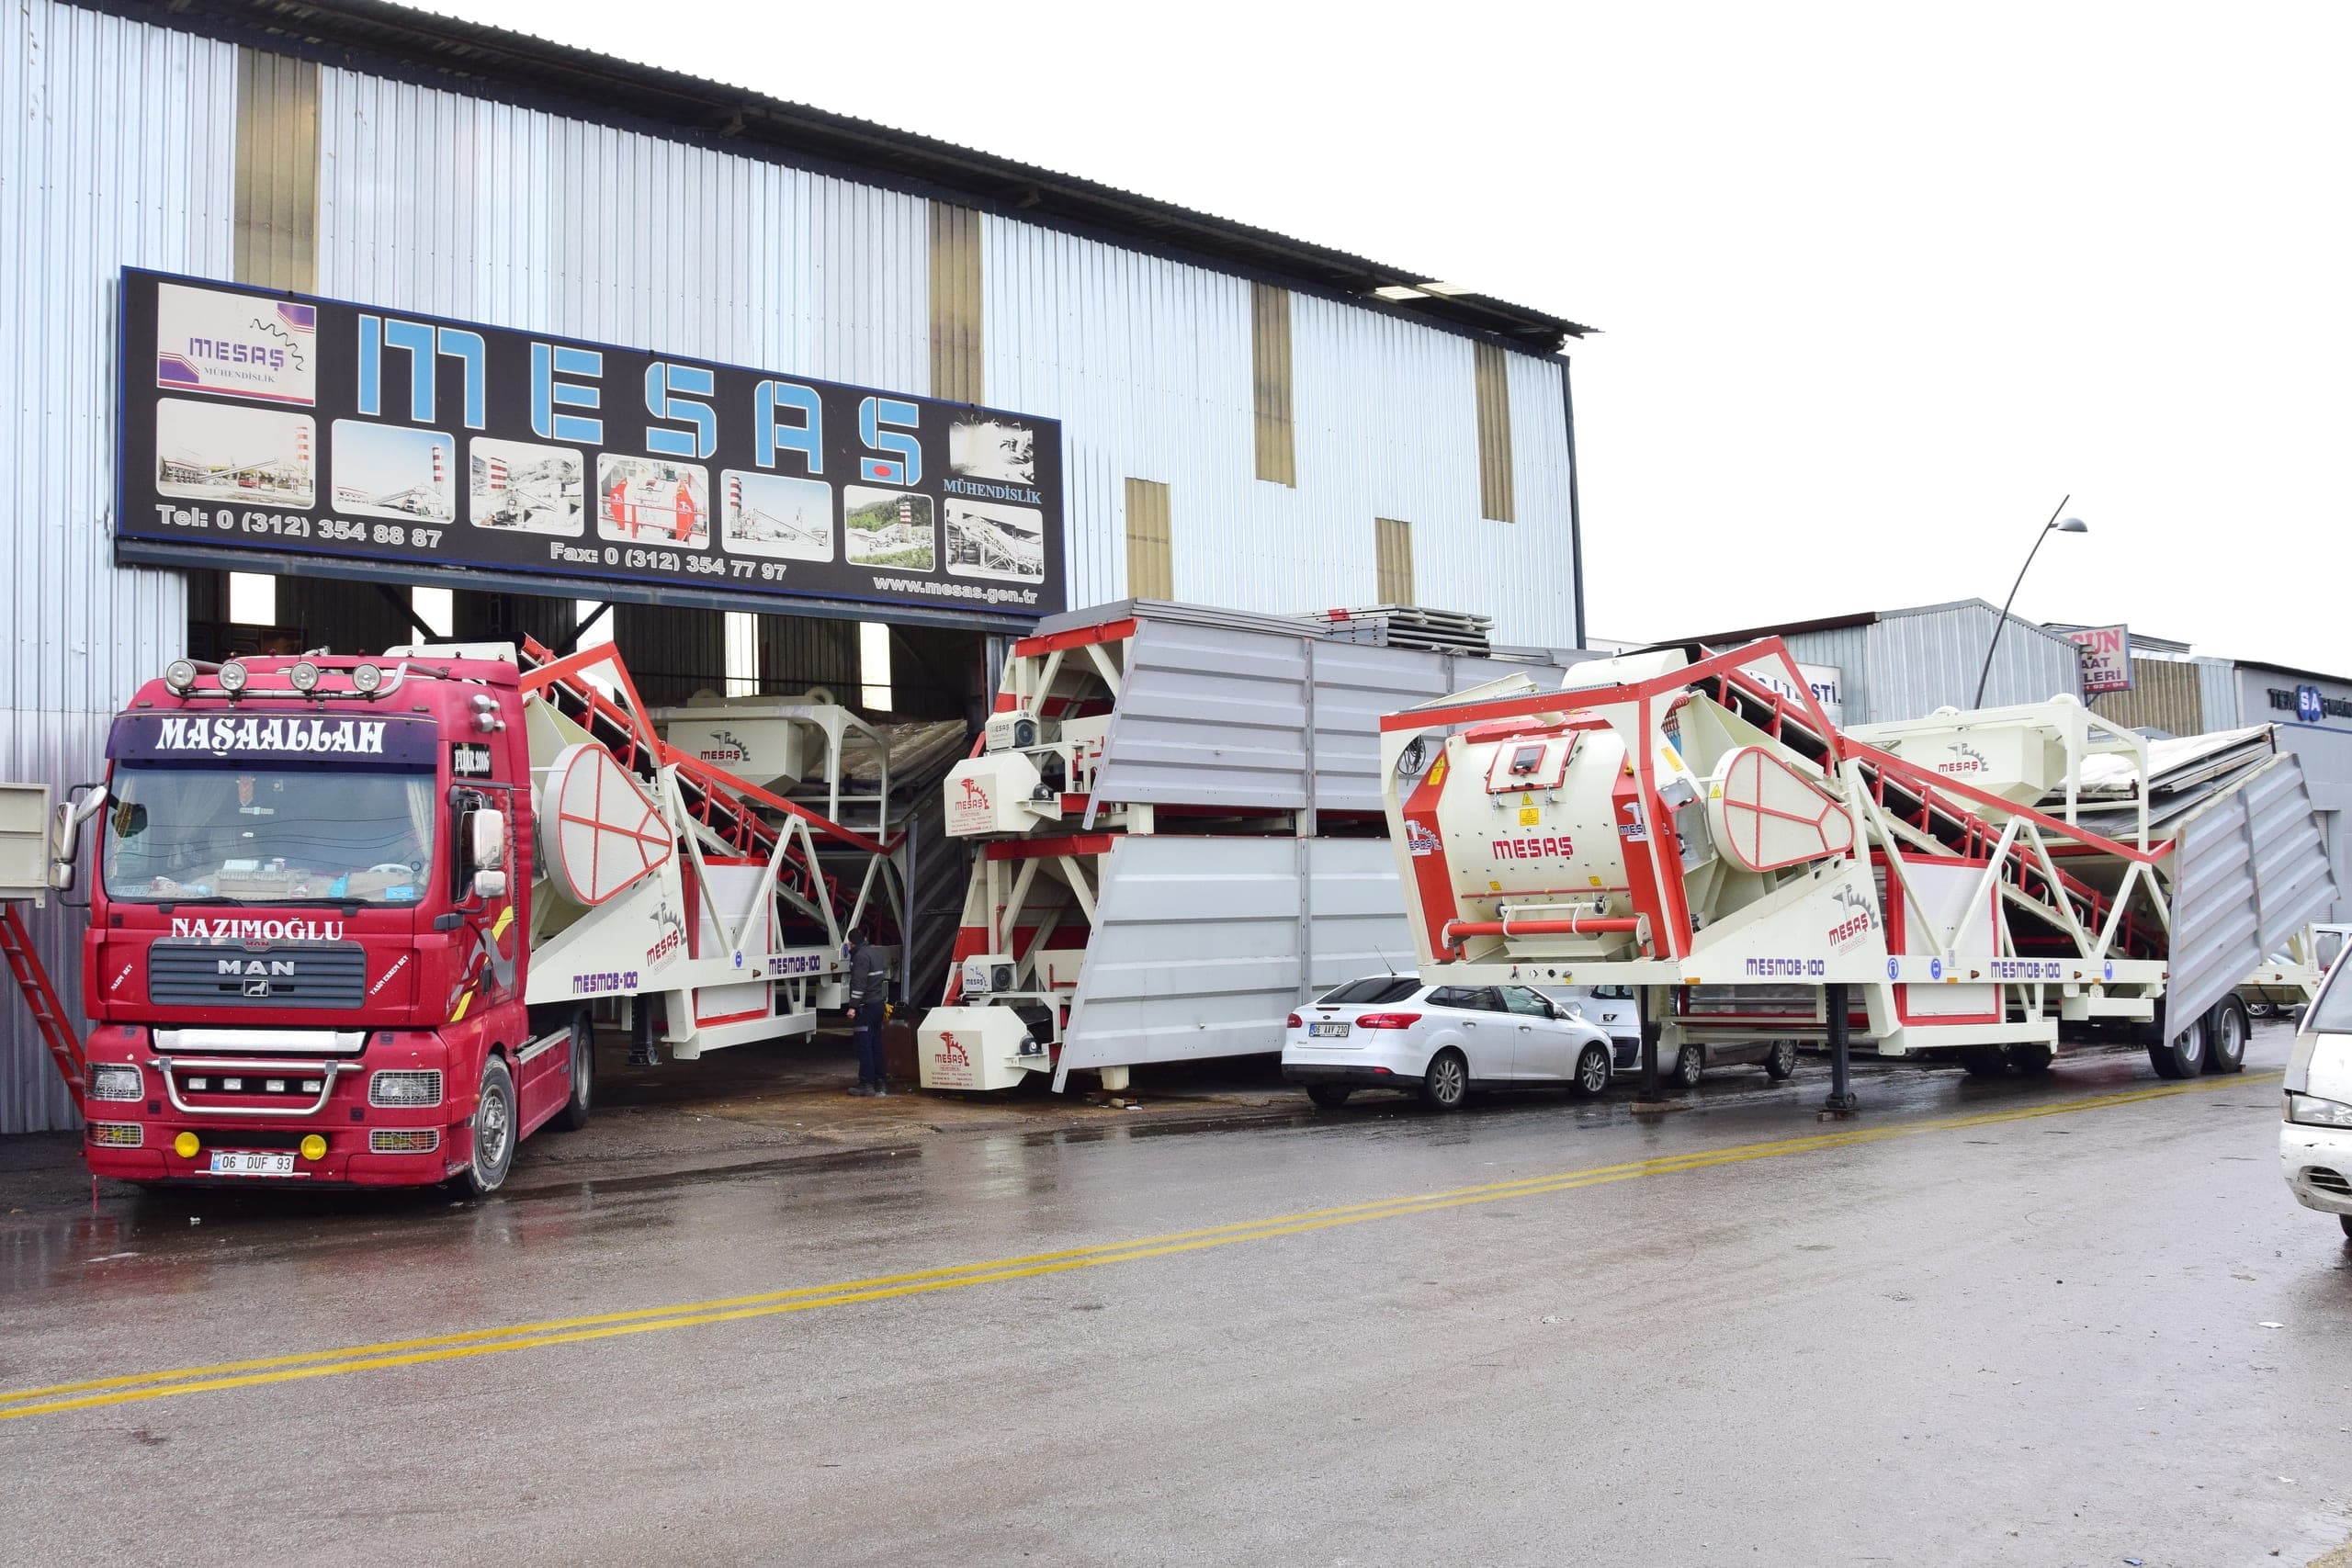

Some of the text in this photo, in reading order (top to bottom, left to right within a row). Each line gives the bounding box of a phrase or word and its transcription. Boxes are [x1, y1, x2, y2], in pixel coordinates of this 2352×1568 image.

[190, 337, 285, 371] MESAŞ
[204, 367, 277, 384] MÜHENDİSLİK
[944, 479, 1043, 504] MÜHENDİSLİK
[155, 503, 443, 548] Tel: 0 (312) 354 88 87
[550, 542, 786, 581] Fax: 0 (312) 354 77 97
[873, 577, 1038, 604] www.mesas.gen.tr
[155, 717, 386, 756] MAŞAALLAH
[700, 750, 741, 761] MESAŞ
[1492, 836, 1574, 860] MESAŞ
[171, 917, 345, 942] NAZIMOĞLU
[1828, 913, 1869, 947] MESAŞ
[646, 930, 679, 967] MESAŞ
[218, 960, 295, 976] MAN
[768, 955, 820, 976] MESMOB-100
[1747, 958, 1825, 976] MESMOB-100
[1990, 961, 2061, 979] MESMOB-100
[572, 971, 638, 994] MESMOB-100
[222, 1156, 291, 1170] 06 DUF 93
